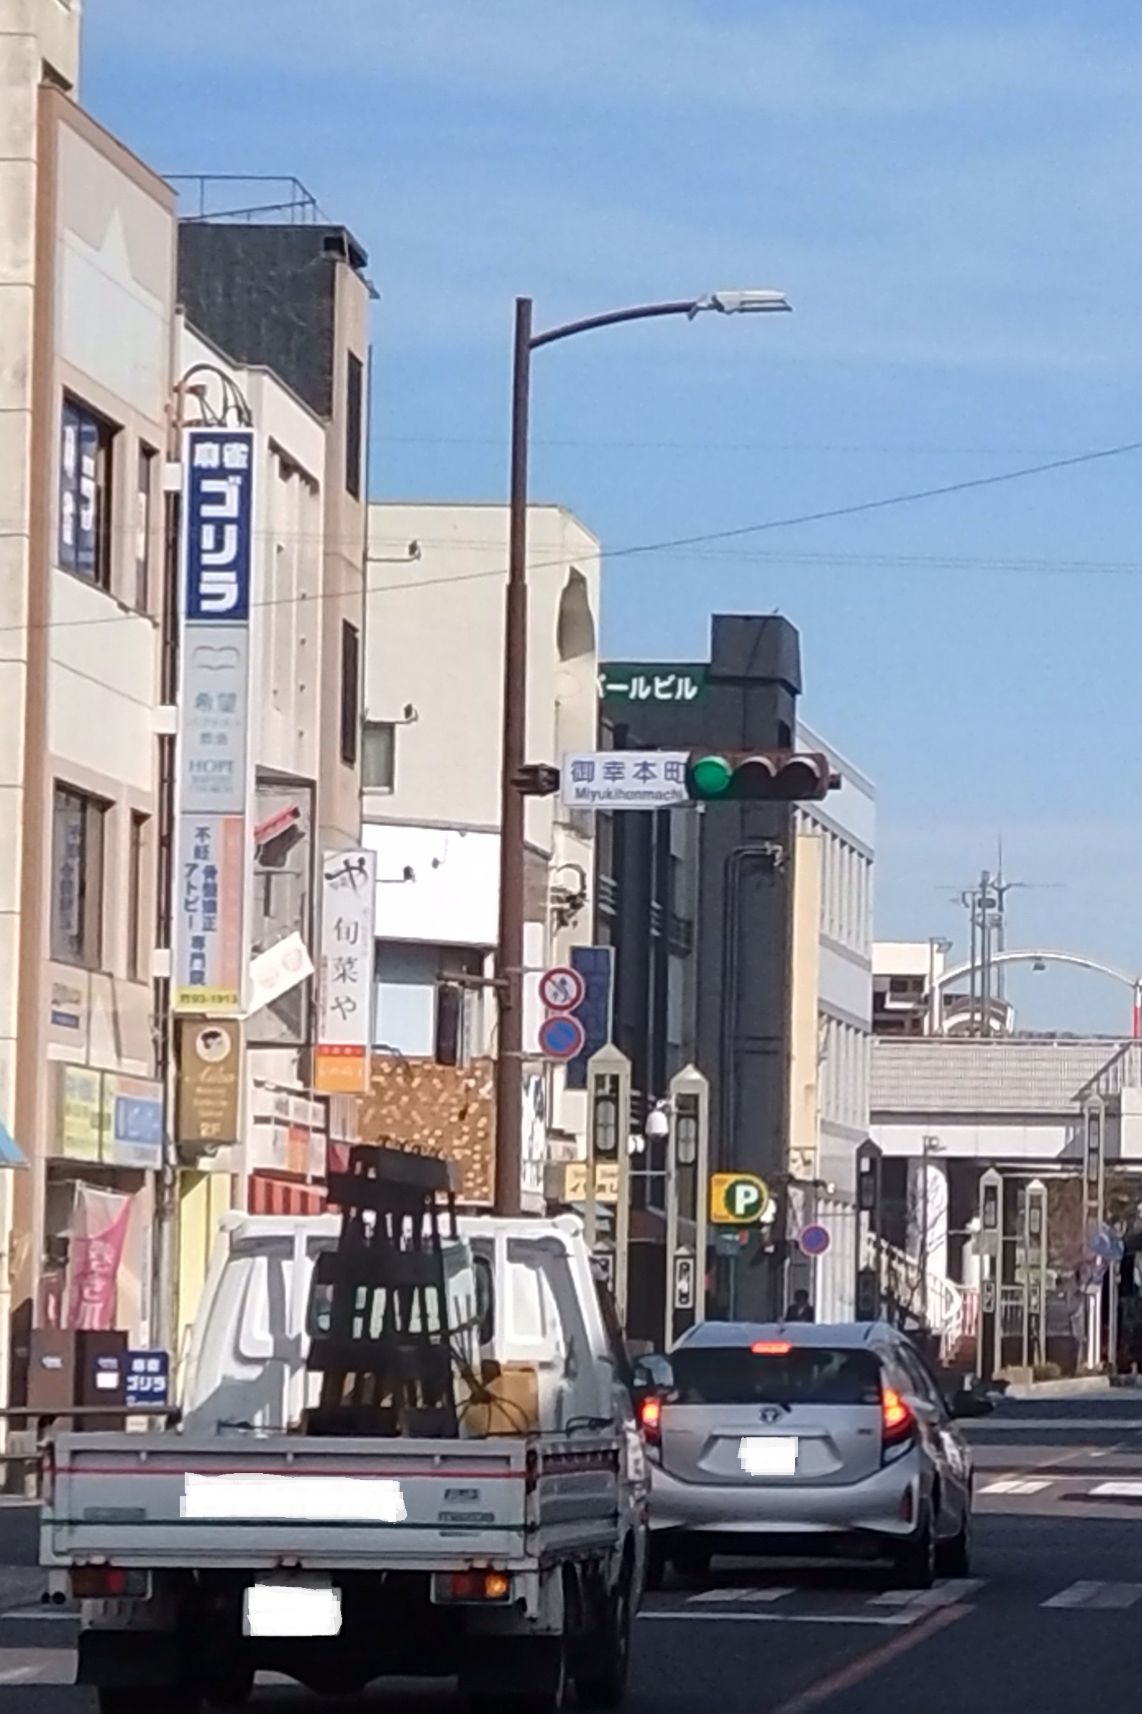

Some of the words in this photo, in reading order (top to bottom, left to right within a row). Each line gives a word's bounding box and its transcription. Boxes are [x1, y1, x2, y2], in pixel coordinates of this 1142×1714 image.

[199, 475, 243, 613] ゴリラ
[571, 760, 686, 784] 御幸本町
[184, 863, 199, 930] アトピー
[735, 1185, 758, 1214] P
